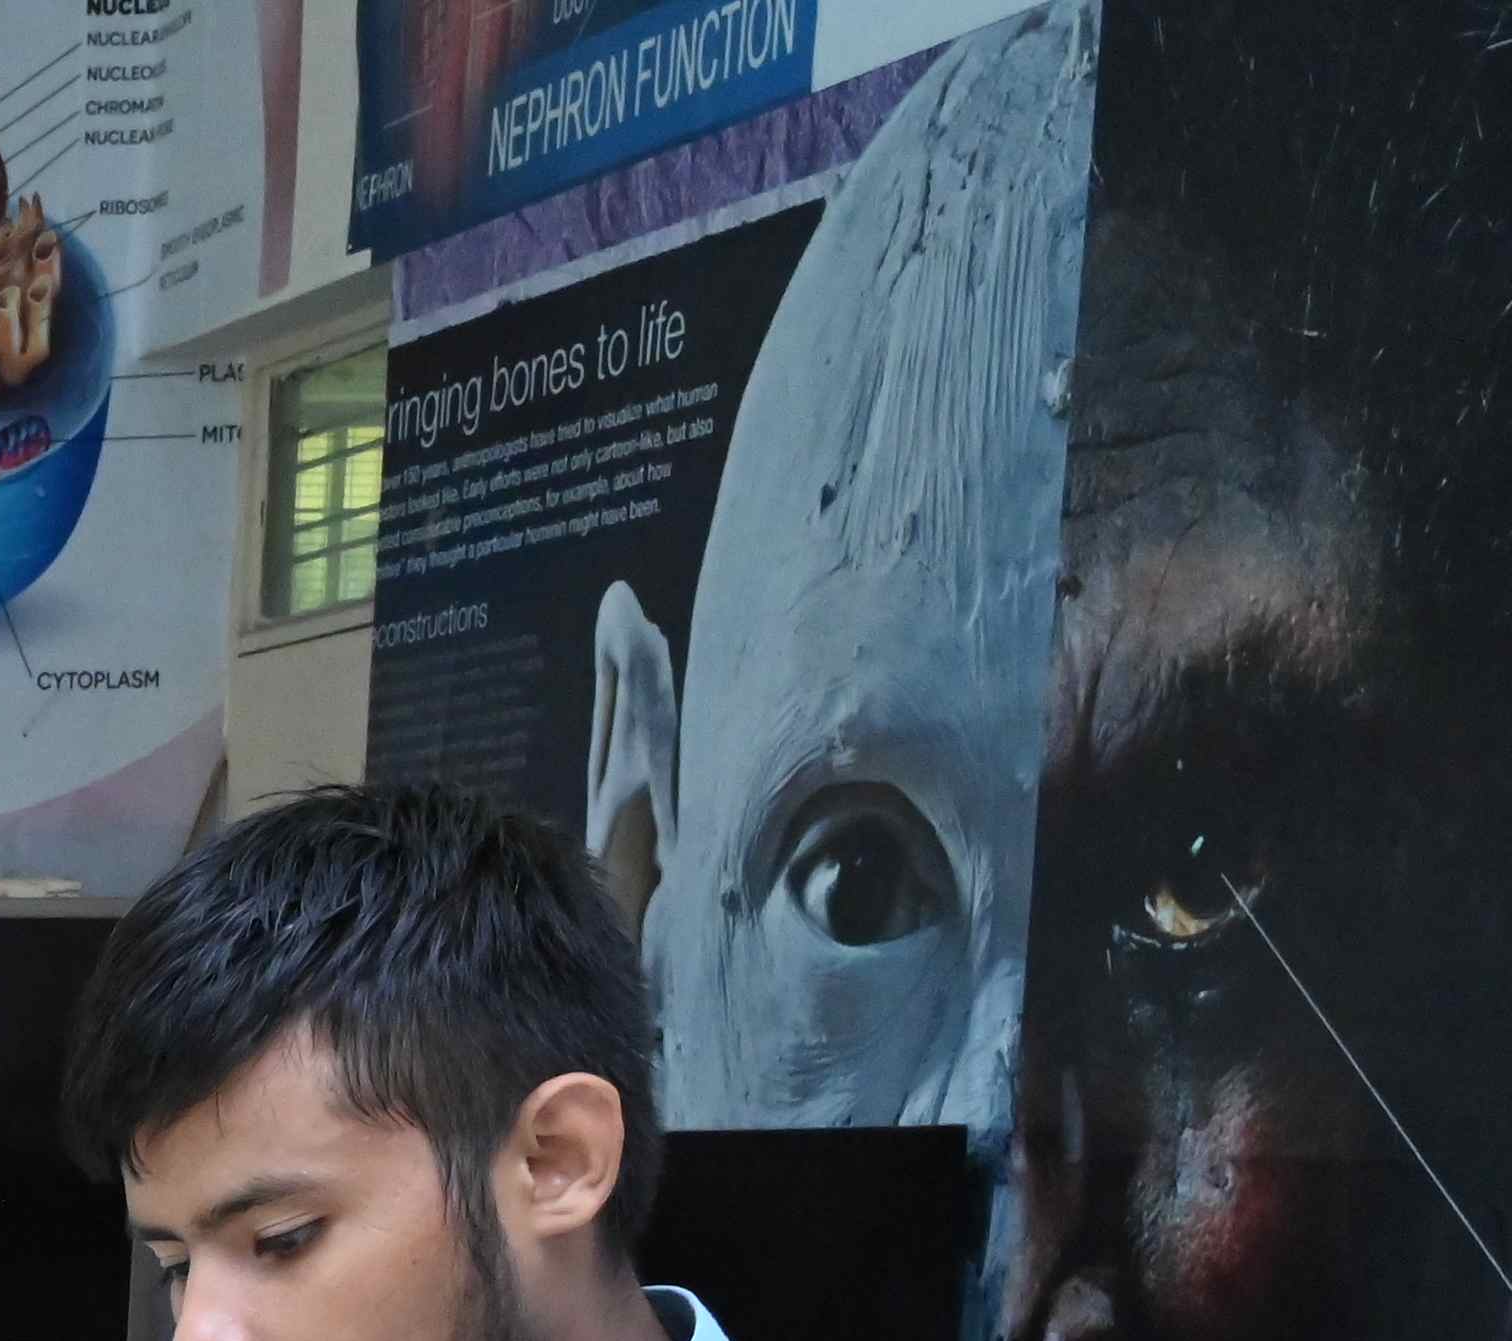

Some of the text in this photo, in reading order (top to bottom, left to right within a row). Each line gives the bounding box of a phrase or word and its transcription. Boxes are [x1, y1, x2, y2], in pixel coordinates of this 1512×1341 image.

[488, 0, 795, 176] NEPHRON FUNCTION
[489, 342, 585, 413] bones
[596, 324, 629, 381] to
[637, 300, 687, 369] life
[677, 382, 719, 409] human
[667, 424, 687, 446] but
[688, 416, 715, 440] also
[36, 670, 160, 691] CYTOPLASM
